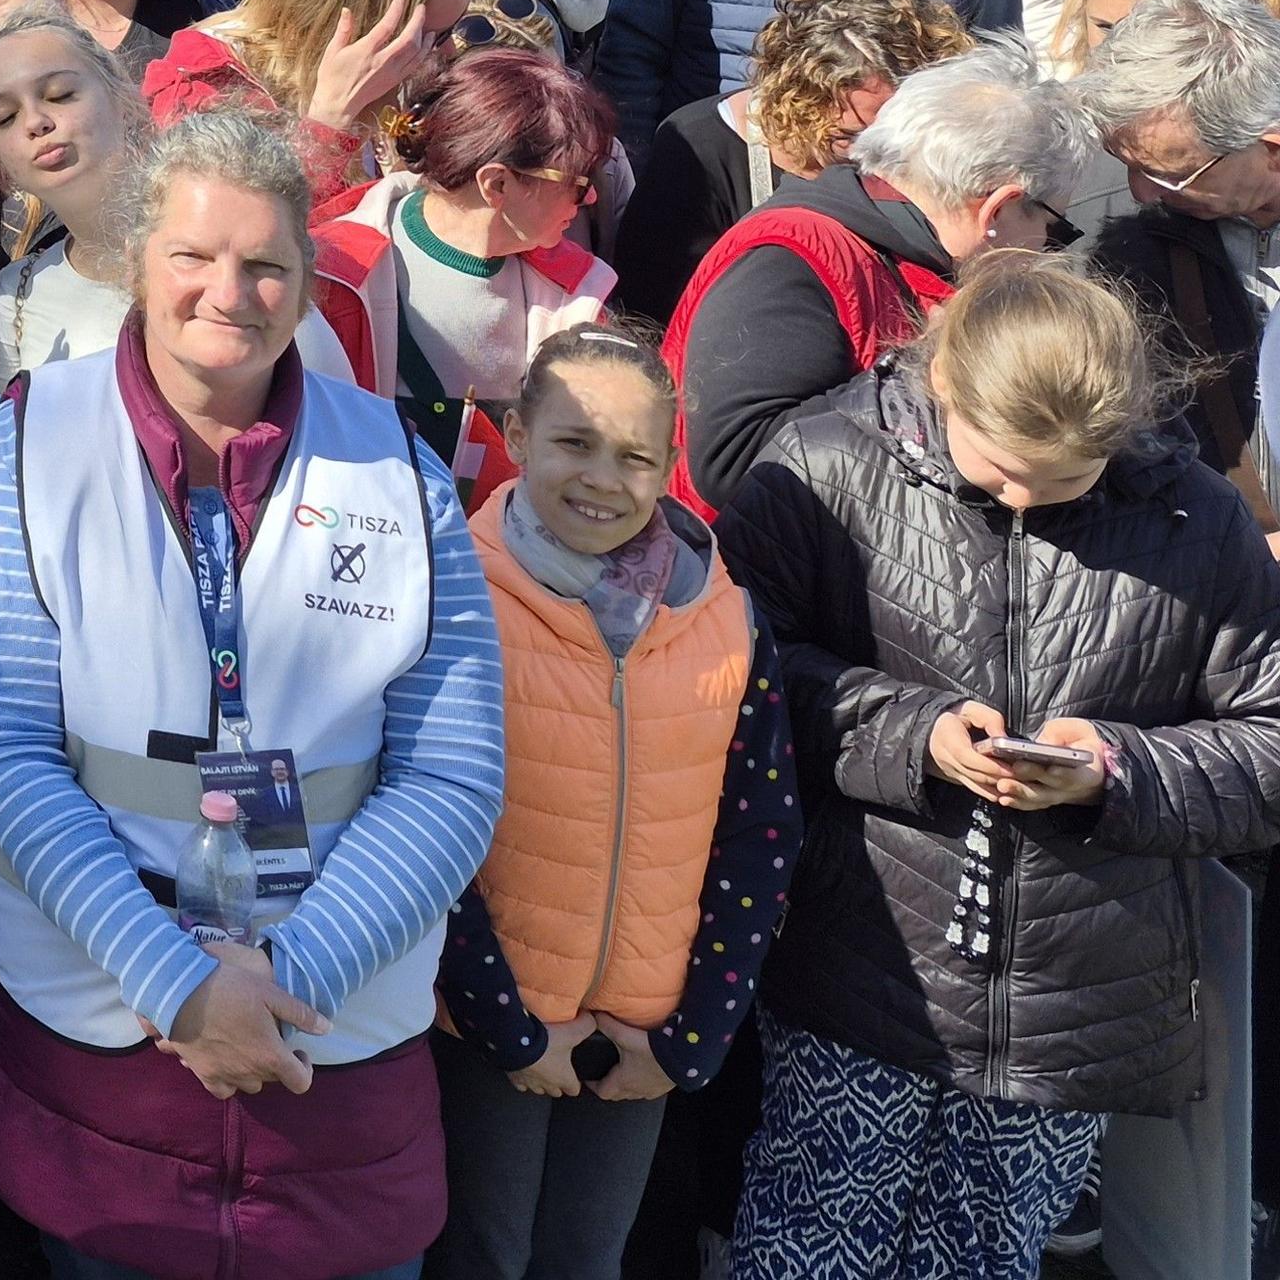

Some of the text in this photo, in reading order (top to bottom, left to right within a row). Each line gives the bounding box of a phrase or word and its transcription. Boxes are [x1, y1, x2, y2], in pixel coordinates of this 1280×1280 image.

[346, 513, 403, 536] TISZA
[197, 552, 214, 609] TISZA
[304, 592, 395, 622] SZAVAZZ!
